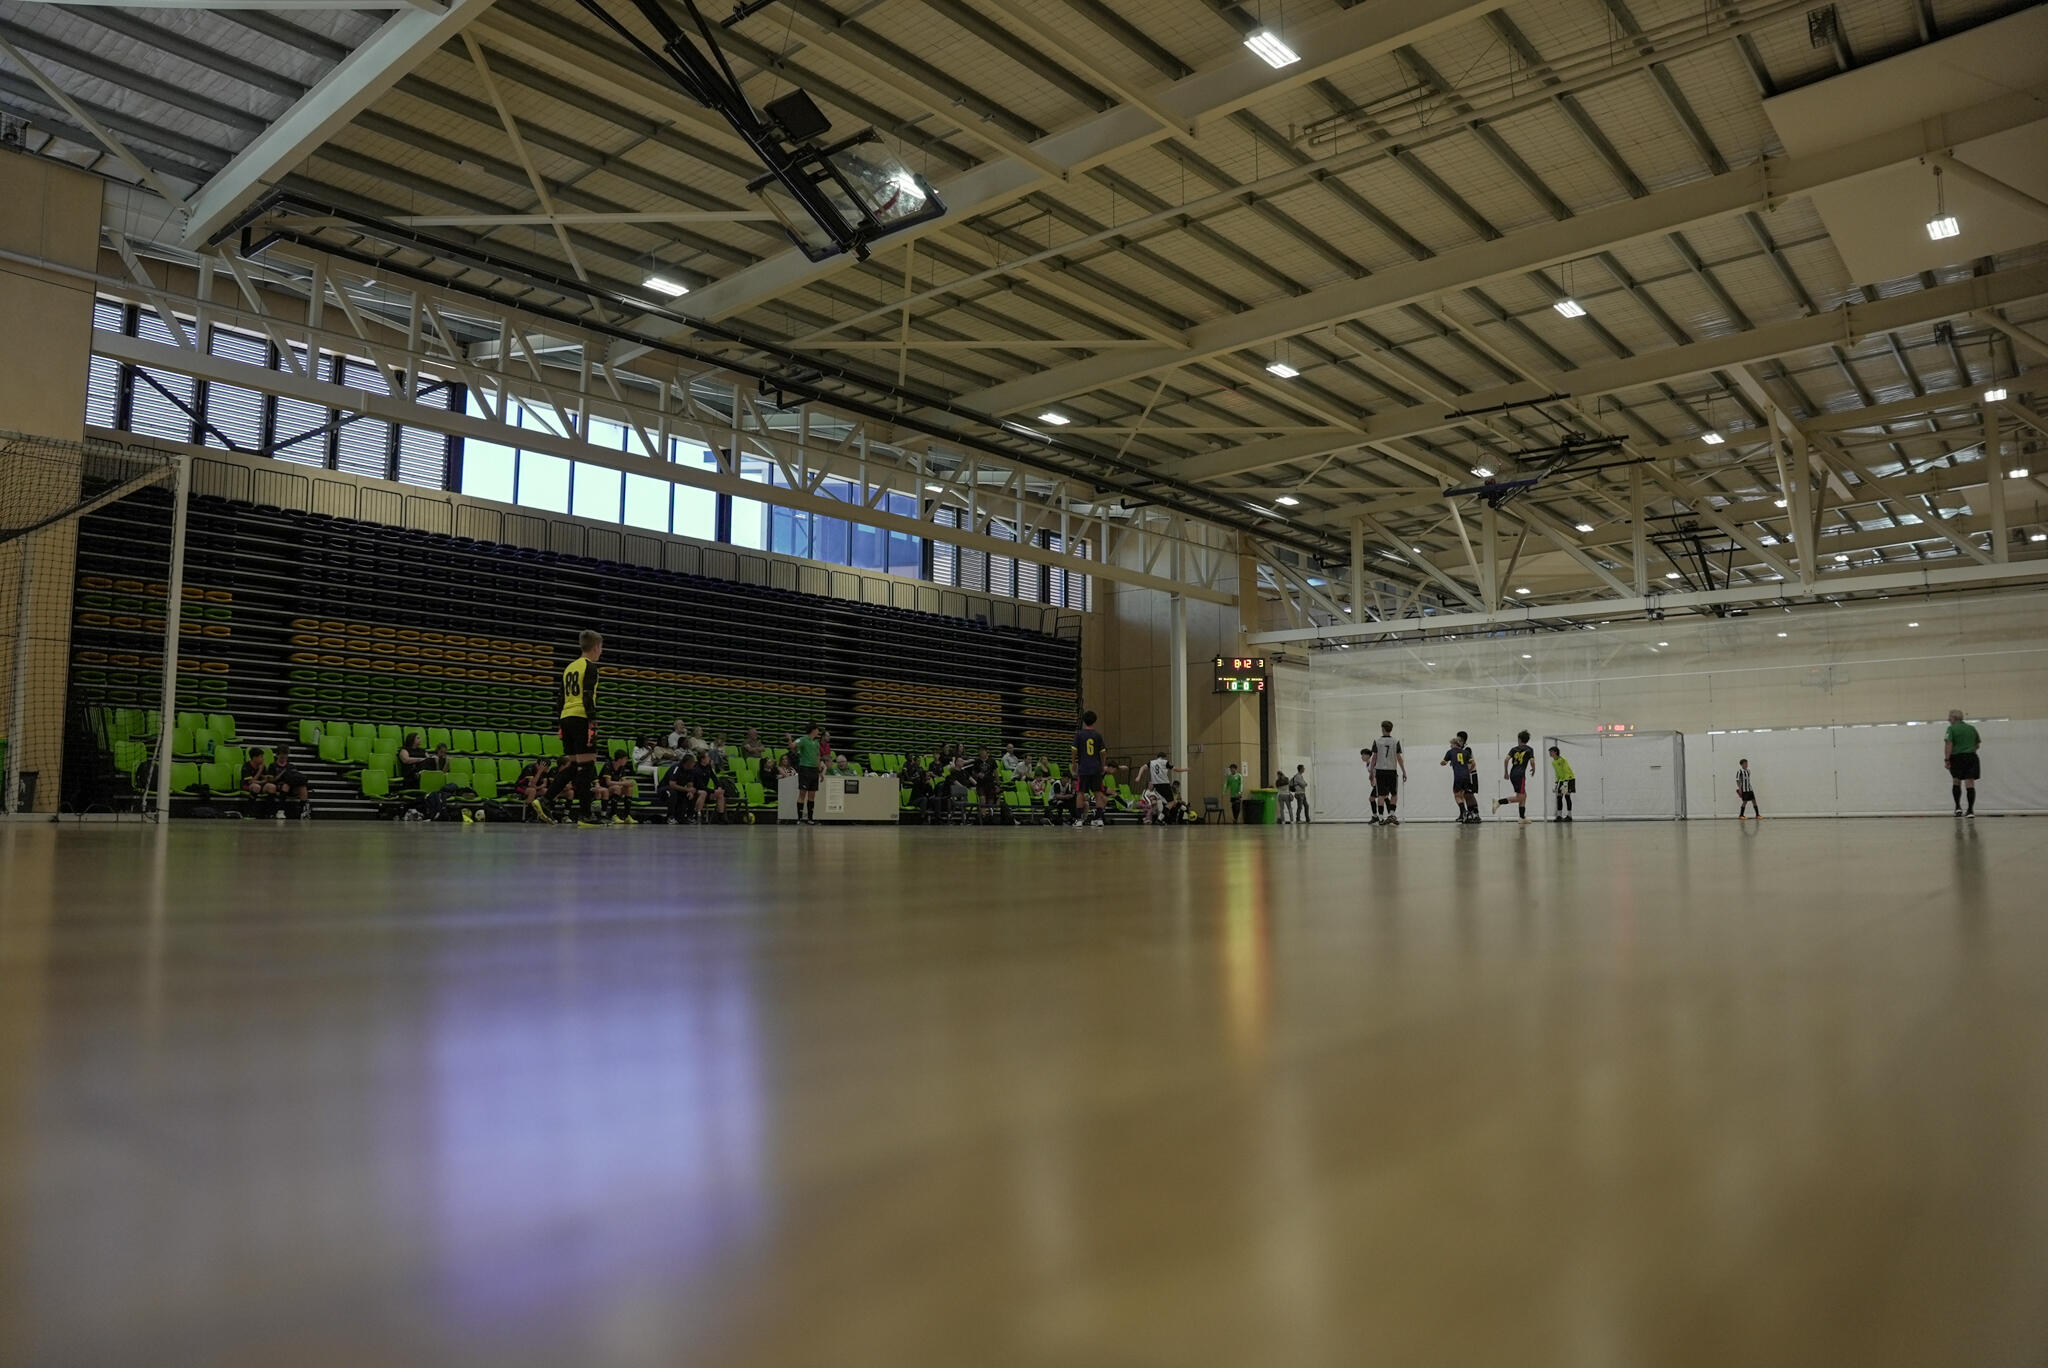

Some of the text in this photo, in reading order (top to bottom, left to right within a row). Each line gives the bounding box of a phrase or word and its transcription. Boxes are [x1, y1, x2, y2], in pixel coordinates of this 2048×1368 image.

[1217, 658, 1222, 667] 3
[565, 671, 580, 697] 88
[1086, 738, 1094, 756] 6
[1384, 745, 1390, 758] 7
[1457, 752, 1464, 765] 9
[1155, 764, 1160, 775] 9
